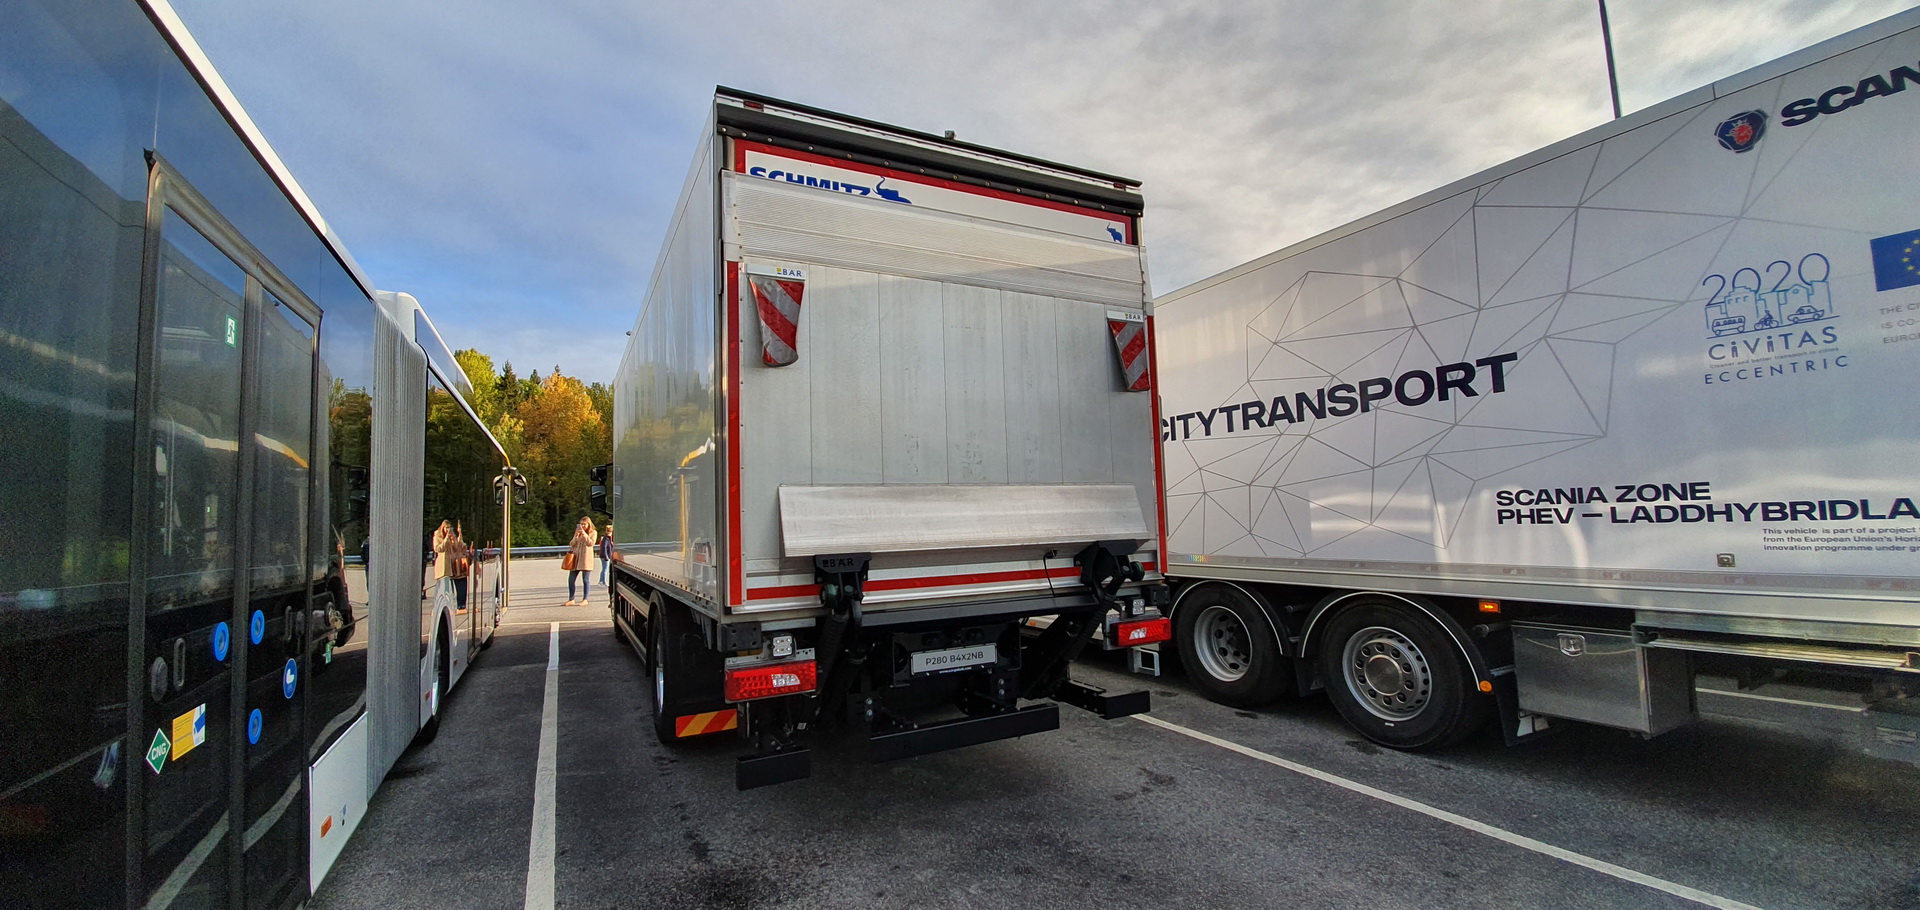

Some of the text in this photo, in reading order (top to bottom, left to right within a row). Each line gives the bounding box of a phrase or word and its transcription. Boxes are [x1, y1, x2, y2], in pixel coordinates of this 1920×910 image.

[1880, 305, 1902, 314] THE
[1704, 355, 1849, 385] ECCENTRIC
[1496, 481, 1711, 507] SCANIA ZONE
[1497, 507, 1575, 525] PHEV
[1762, 527, 1782, 535] This
[1783, 527, 1818, 535] vehicle
[1833, 527, 1854, 535] part
[1856, 526, 1867, 534] of
[1877, 526, 1917, 535] project
[1804, 536, 1851, 544] European
[1814, 545, 1873, 553] programme
[1875, 544, 1907, 552] under
[925, 651, 984, 666] P280 B4X2NB
[151, 742, 167, 761] CNG
